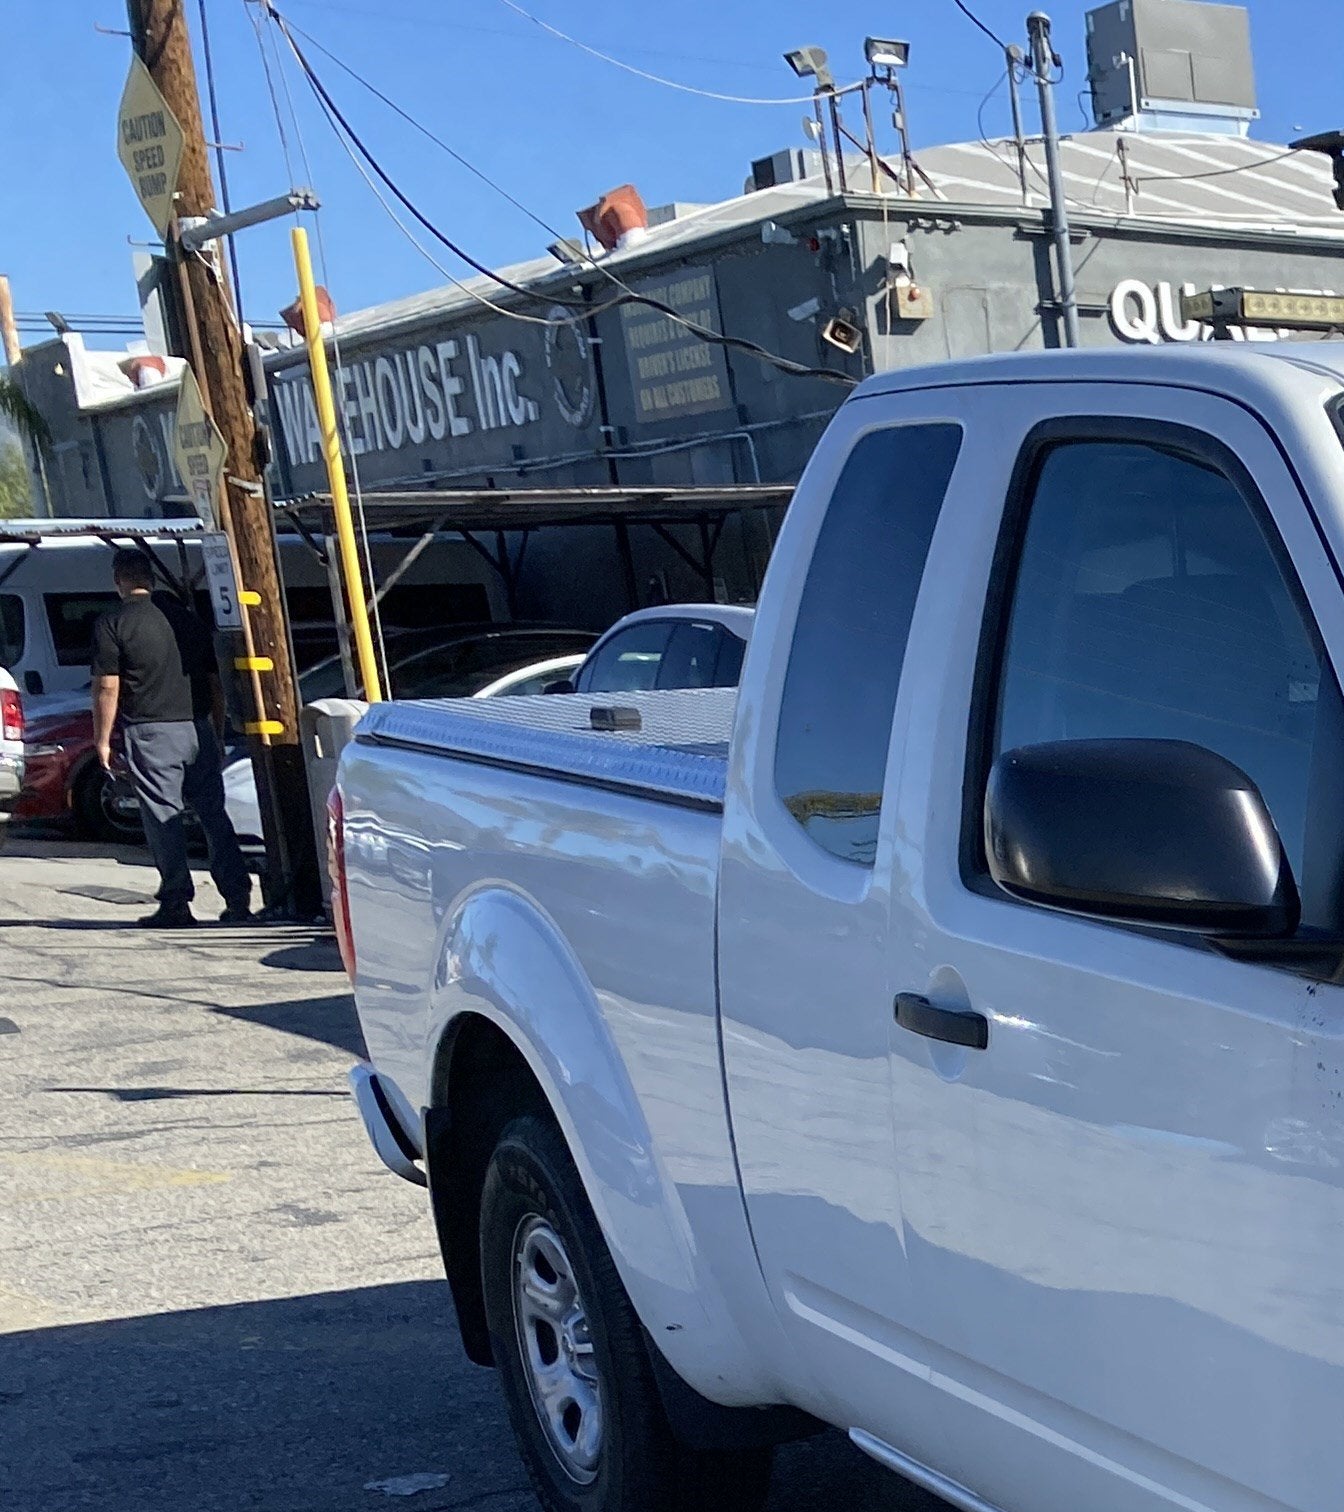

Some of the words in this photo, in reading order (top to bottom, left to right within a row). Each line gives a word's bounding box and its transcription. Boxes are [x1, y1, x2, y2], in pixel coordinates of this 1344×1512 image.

[122, 110, 166, 145] CAUTION
[133, 145, 165, 172] SPEED
[139, 172, 167, 199] BUMP
[273, 340, 469, 466] WAEHOUSE
[466, 333, 540, 430] Inc.
[219, 586, 232, 614] 5
